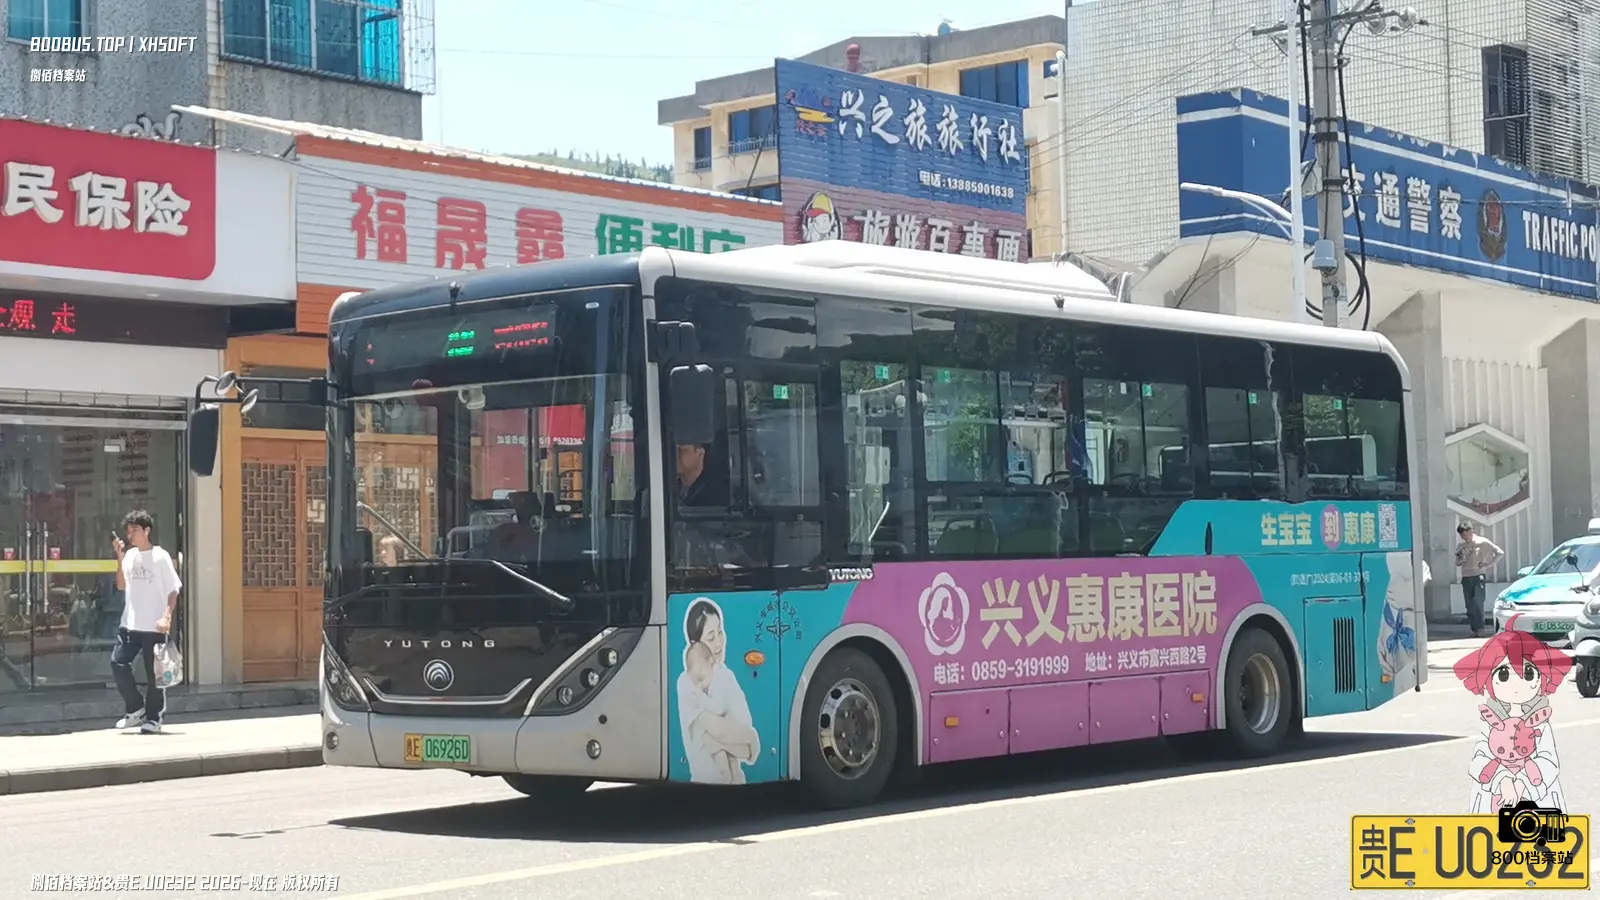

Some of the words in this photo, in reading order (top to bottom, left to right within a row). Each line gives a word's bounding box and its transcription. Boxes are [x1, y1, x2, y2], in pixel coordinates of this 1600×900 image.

[838, 88, 1021, 165] 兴之旅旅行社
[0, 161, 192, 237] 民保险
[1522, 209, 1578, 259] TRAFFIC
[829, 567, 874, 581] YUTONG
[979, 570, 1218, 650] 兴义惠康医院
[384, 639, 496, 649] YUTONG
